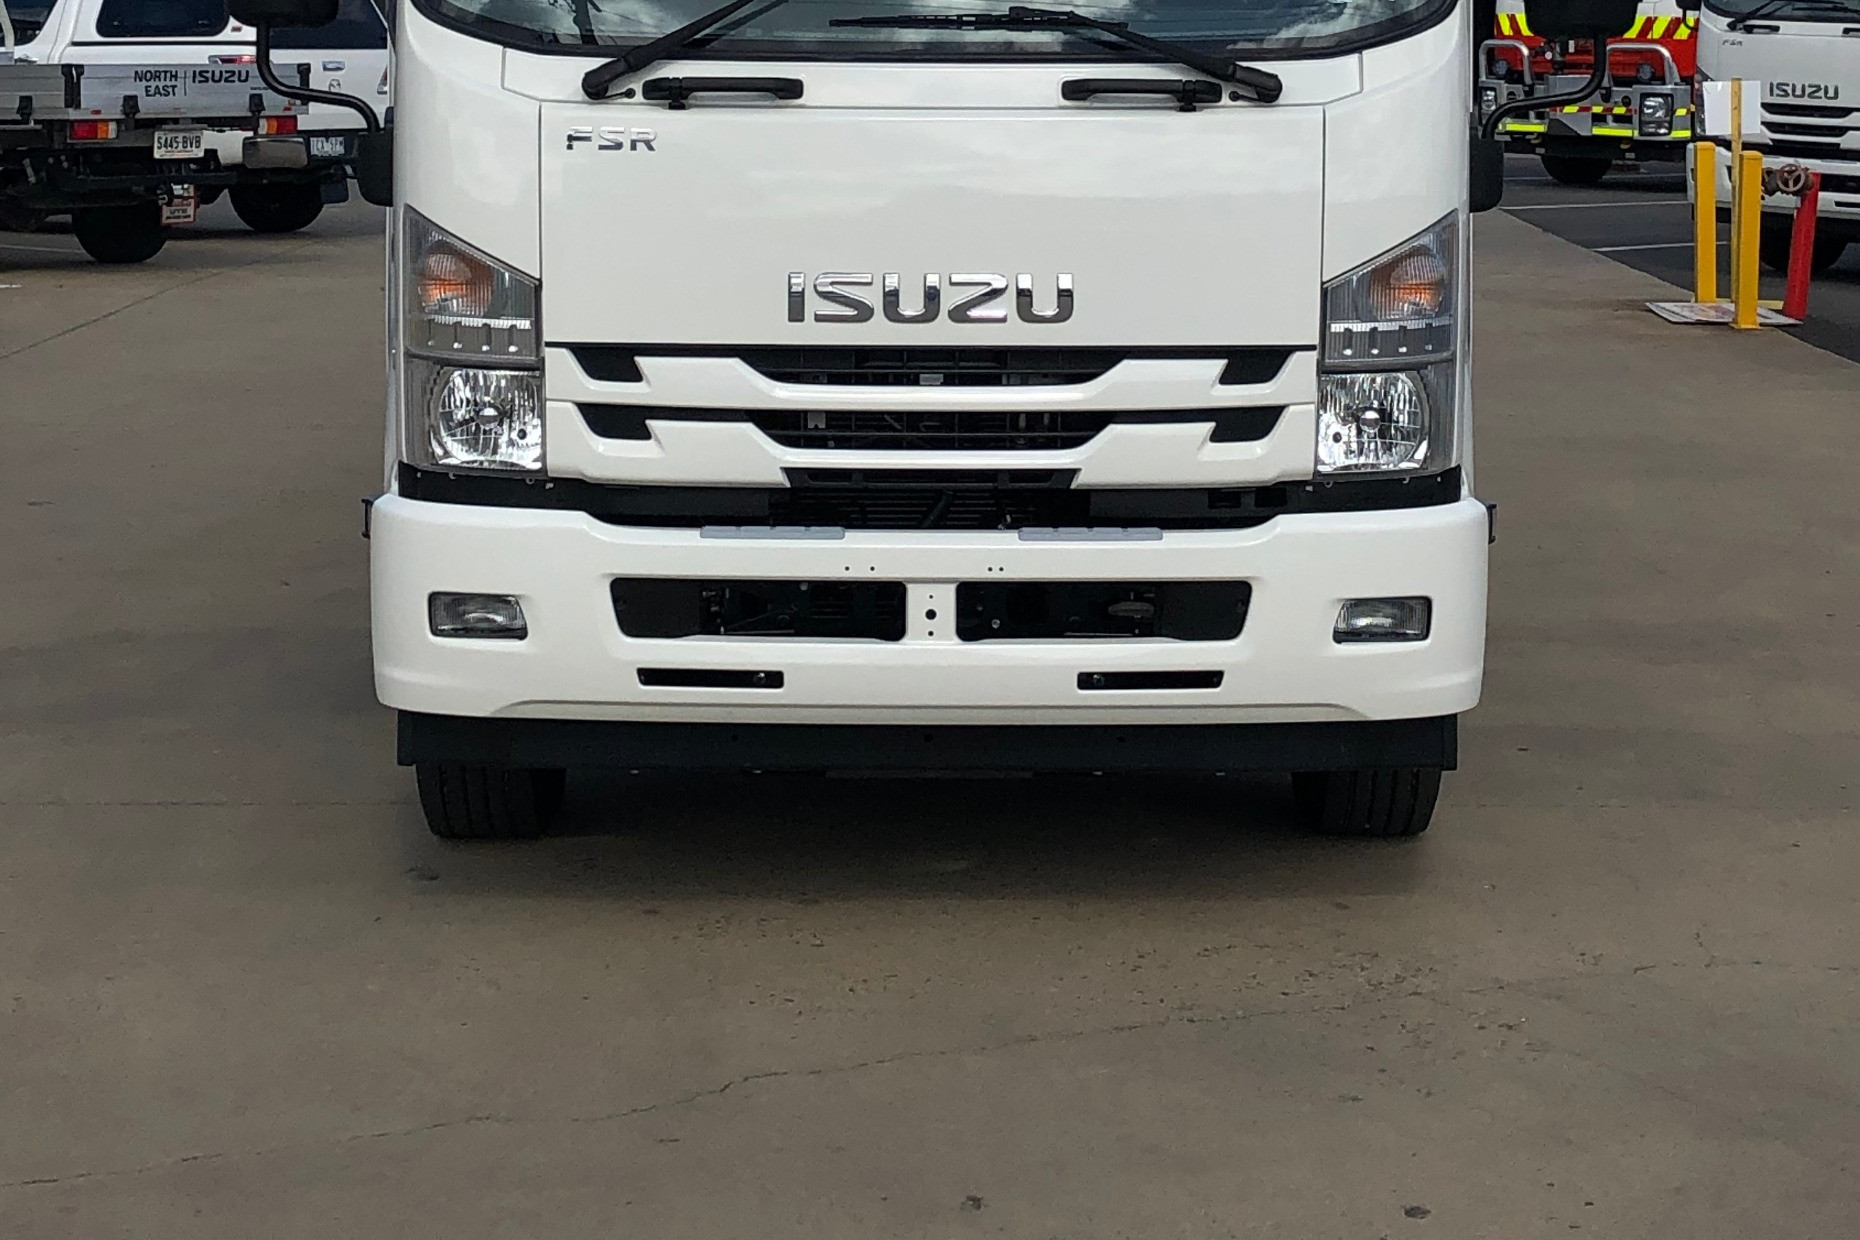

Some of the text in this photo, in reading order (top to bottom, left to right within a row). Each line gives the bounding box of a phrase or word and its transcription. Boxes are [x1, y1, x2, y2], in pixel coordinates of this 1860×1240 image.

[134, 70, 249, 84] NORTH ISUZU
[144, 85, 178, 97] EAST
[1769, 81, 1839, 101] ISUZU
[566, 126, 657, 151] FSR
[787, 271, 1074, 323] ISUZU
